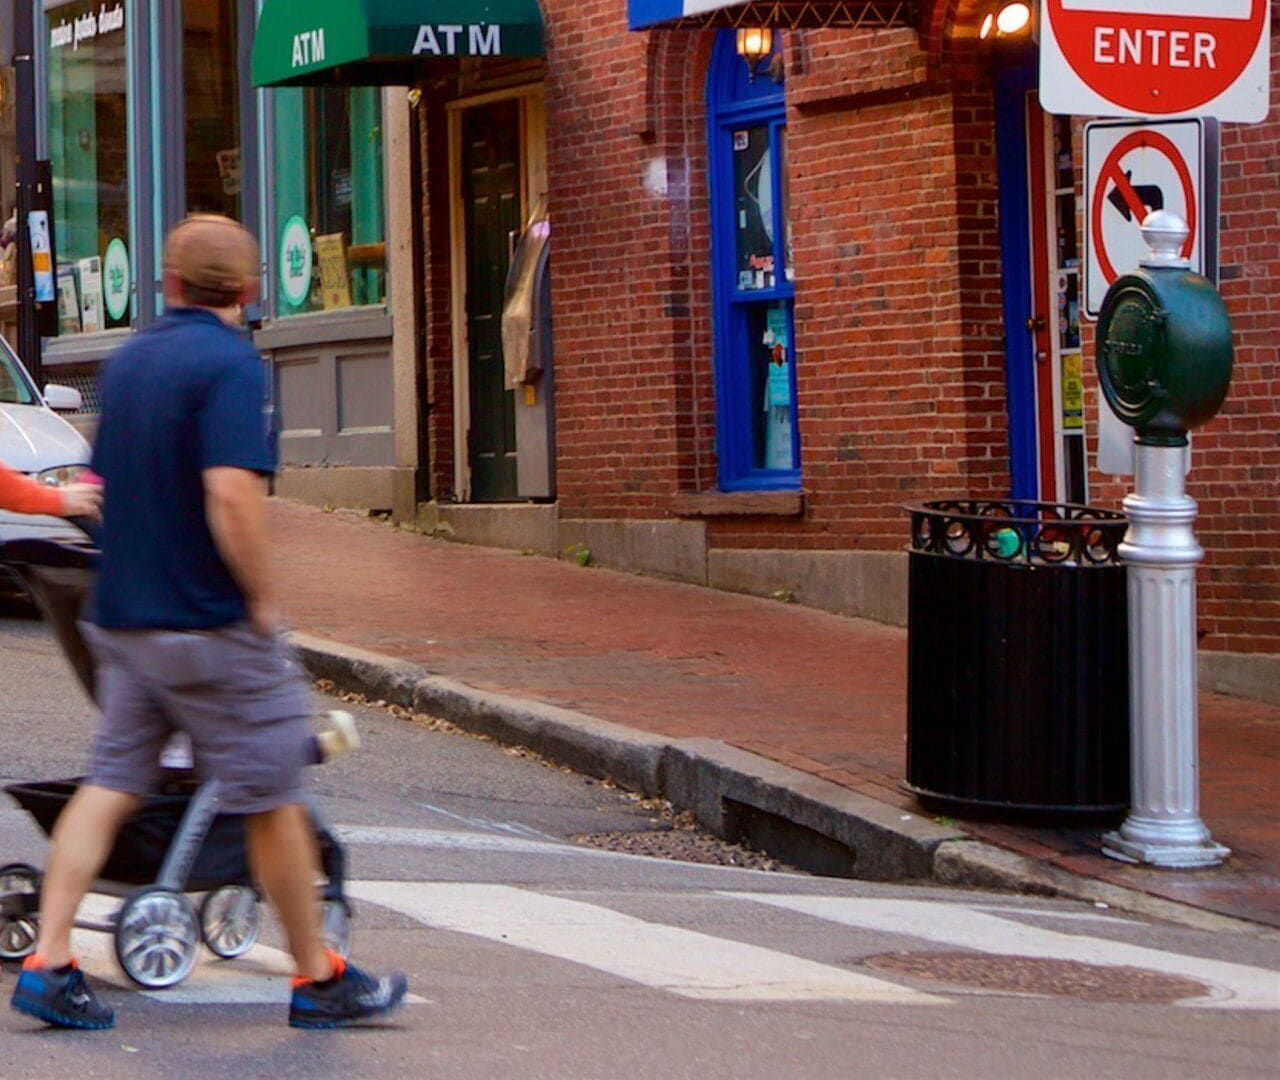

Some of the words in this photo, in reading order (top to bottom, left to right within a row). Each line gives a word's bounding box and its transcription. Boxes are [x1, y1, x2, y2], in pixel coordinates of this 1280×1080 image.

[291, 28, 326, 68] ATM
[412, 24, 501, 56] ATM
[1094, 26, 1217, 69] ENTER
